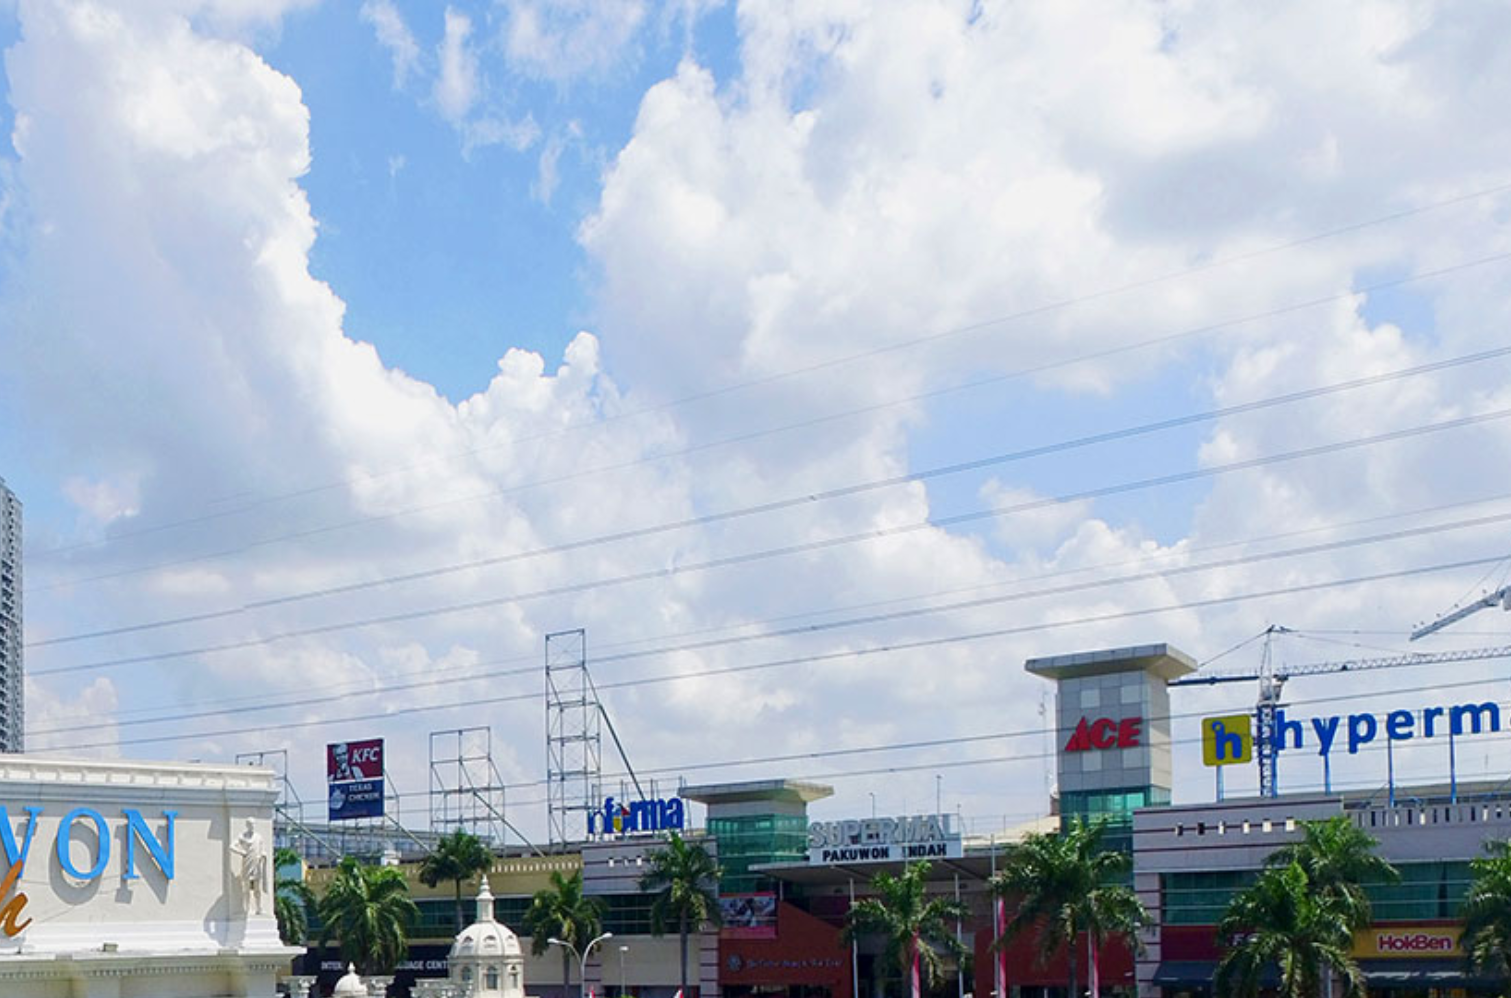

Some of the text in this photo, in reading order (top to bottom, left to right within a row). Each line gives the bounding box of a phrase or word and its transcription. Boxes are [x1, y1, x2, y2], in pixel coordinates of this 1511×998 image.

[1064, 716, 1143, 752] ACE
[1275, 701, 1511, 756] hyperm
[352, 747, 380, 763] KFC
[808, 813, 962, 849] SUPERMAL
[822, 843, 947, 862] PAKUWON INDAH
[1378, 934, 1453, 951] HokBen
